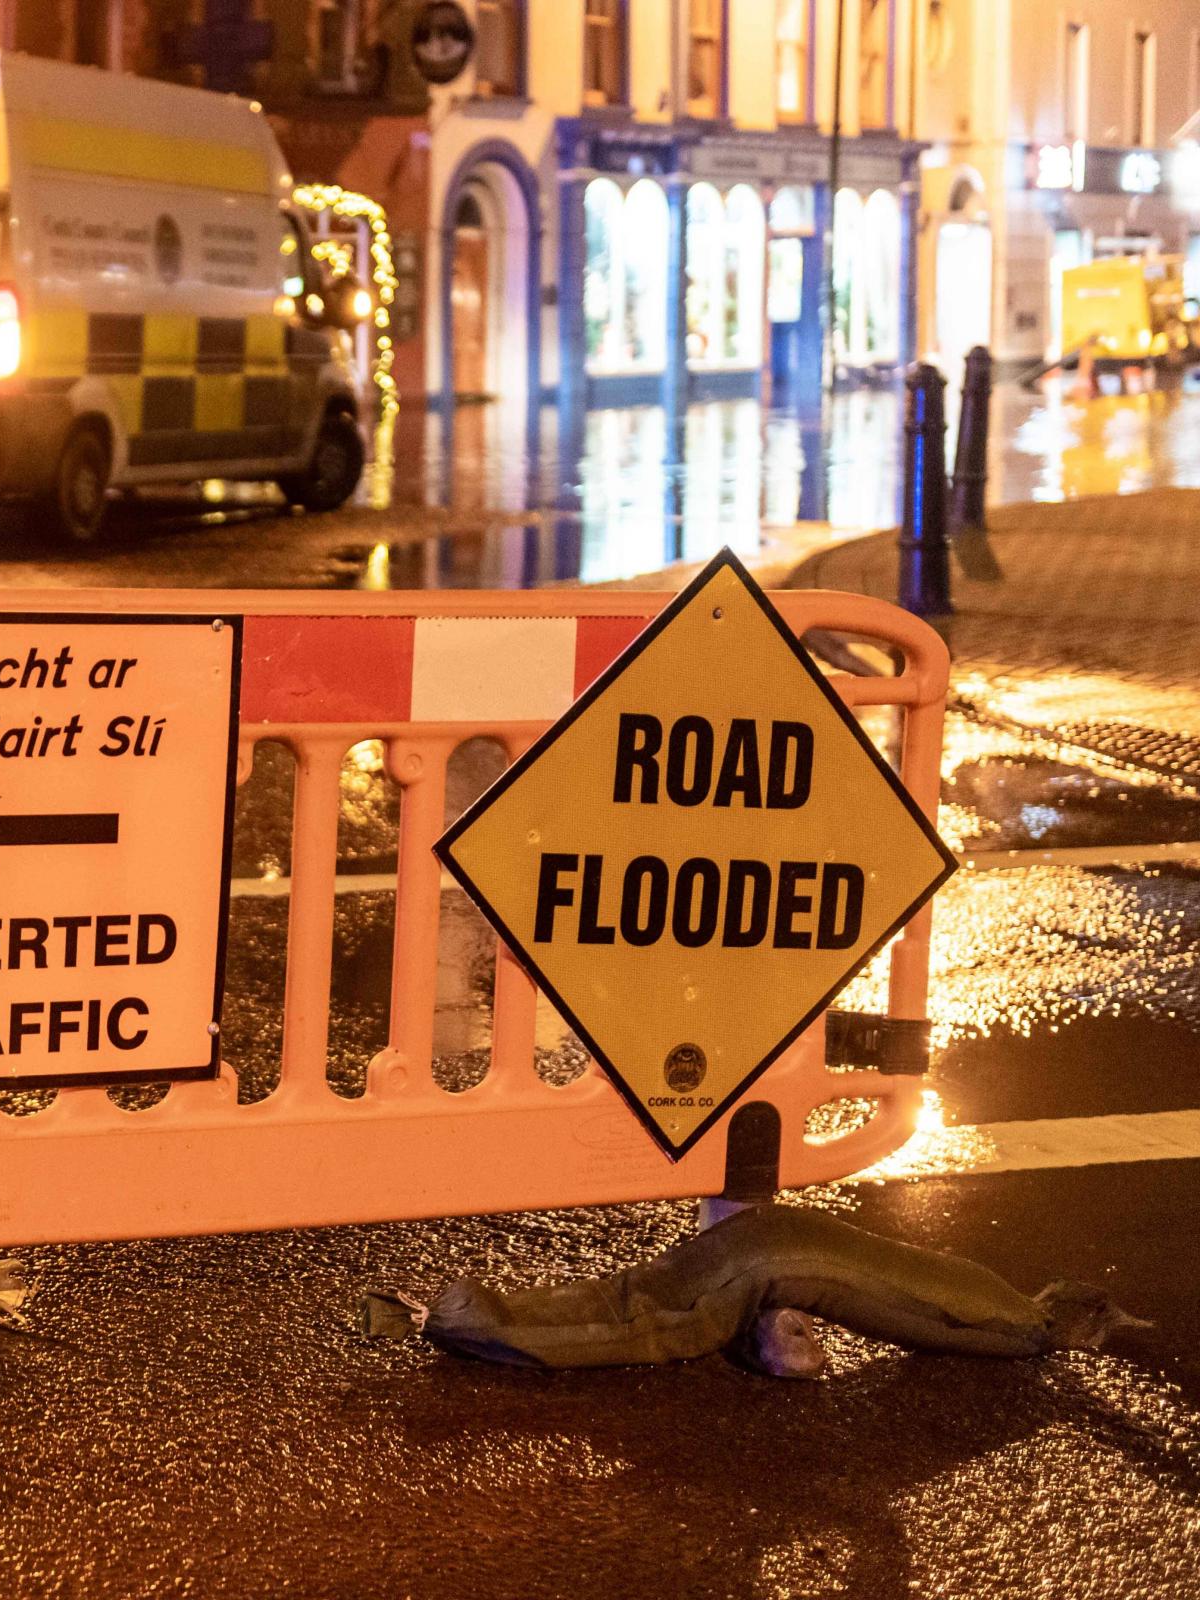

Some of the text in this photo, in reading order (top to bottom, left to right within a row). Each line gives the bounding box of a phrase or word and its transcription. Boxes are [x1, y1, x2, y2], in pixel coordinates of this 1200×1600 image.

[88, 658, 138, 689] ar
[98, 715, 167, 757] Slí
[612, 712, 815, 810] ROAD
[533, 852, 866, 951] FLOODED
[648, 1096, 677, 1107] CORK
